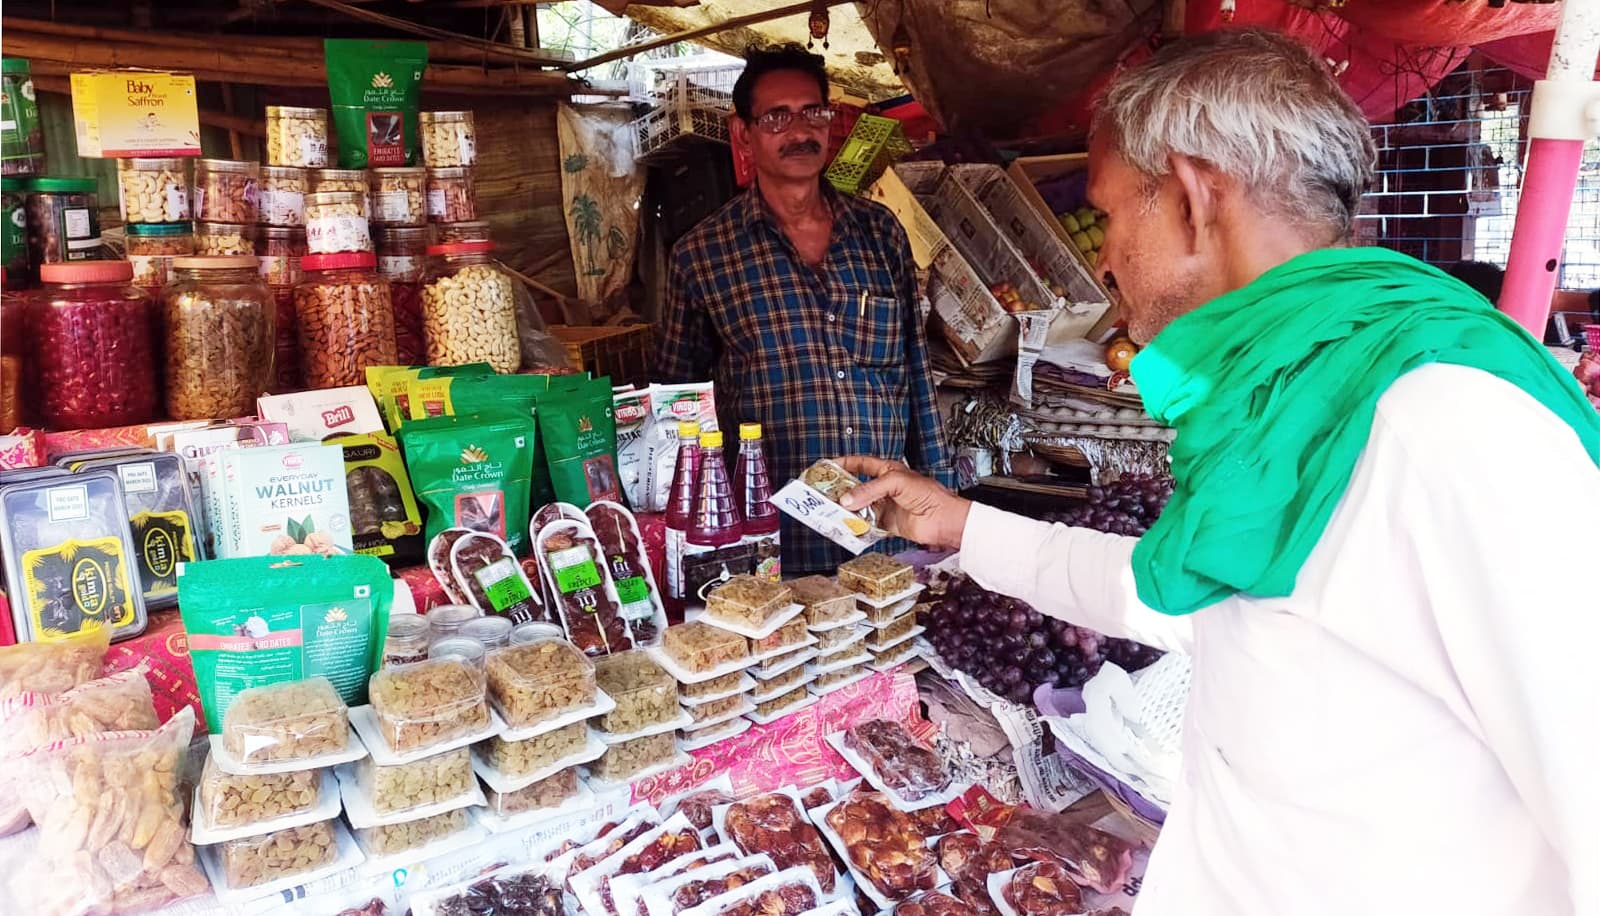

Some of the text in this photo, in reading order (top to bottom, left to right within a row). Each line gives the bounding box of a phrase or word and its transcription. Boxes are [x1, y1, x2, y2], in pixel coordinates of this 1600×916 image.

[126, 80, 153, 96] Baby
[128, 95, 164, 107] Saffron
[363, 95, 380, 103] Date
[325, 408, 352, 424] Brill
[269, 472, 318, 482] EVERYDAY
[452, 470, 504, 483] Date Crown
[255, 478, 334, 499] WALNUT
[270, 495, 323, 510] KERNELS
[155, 535, 168, 571] kimia
[84, 566, 99, 609] kimia
